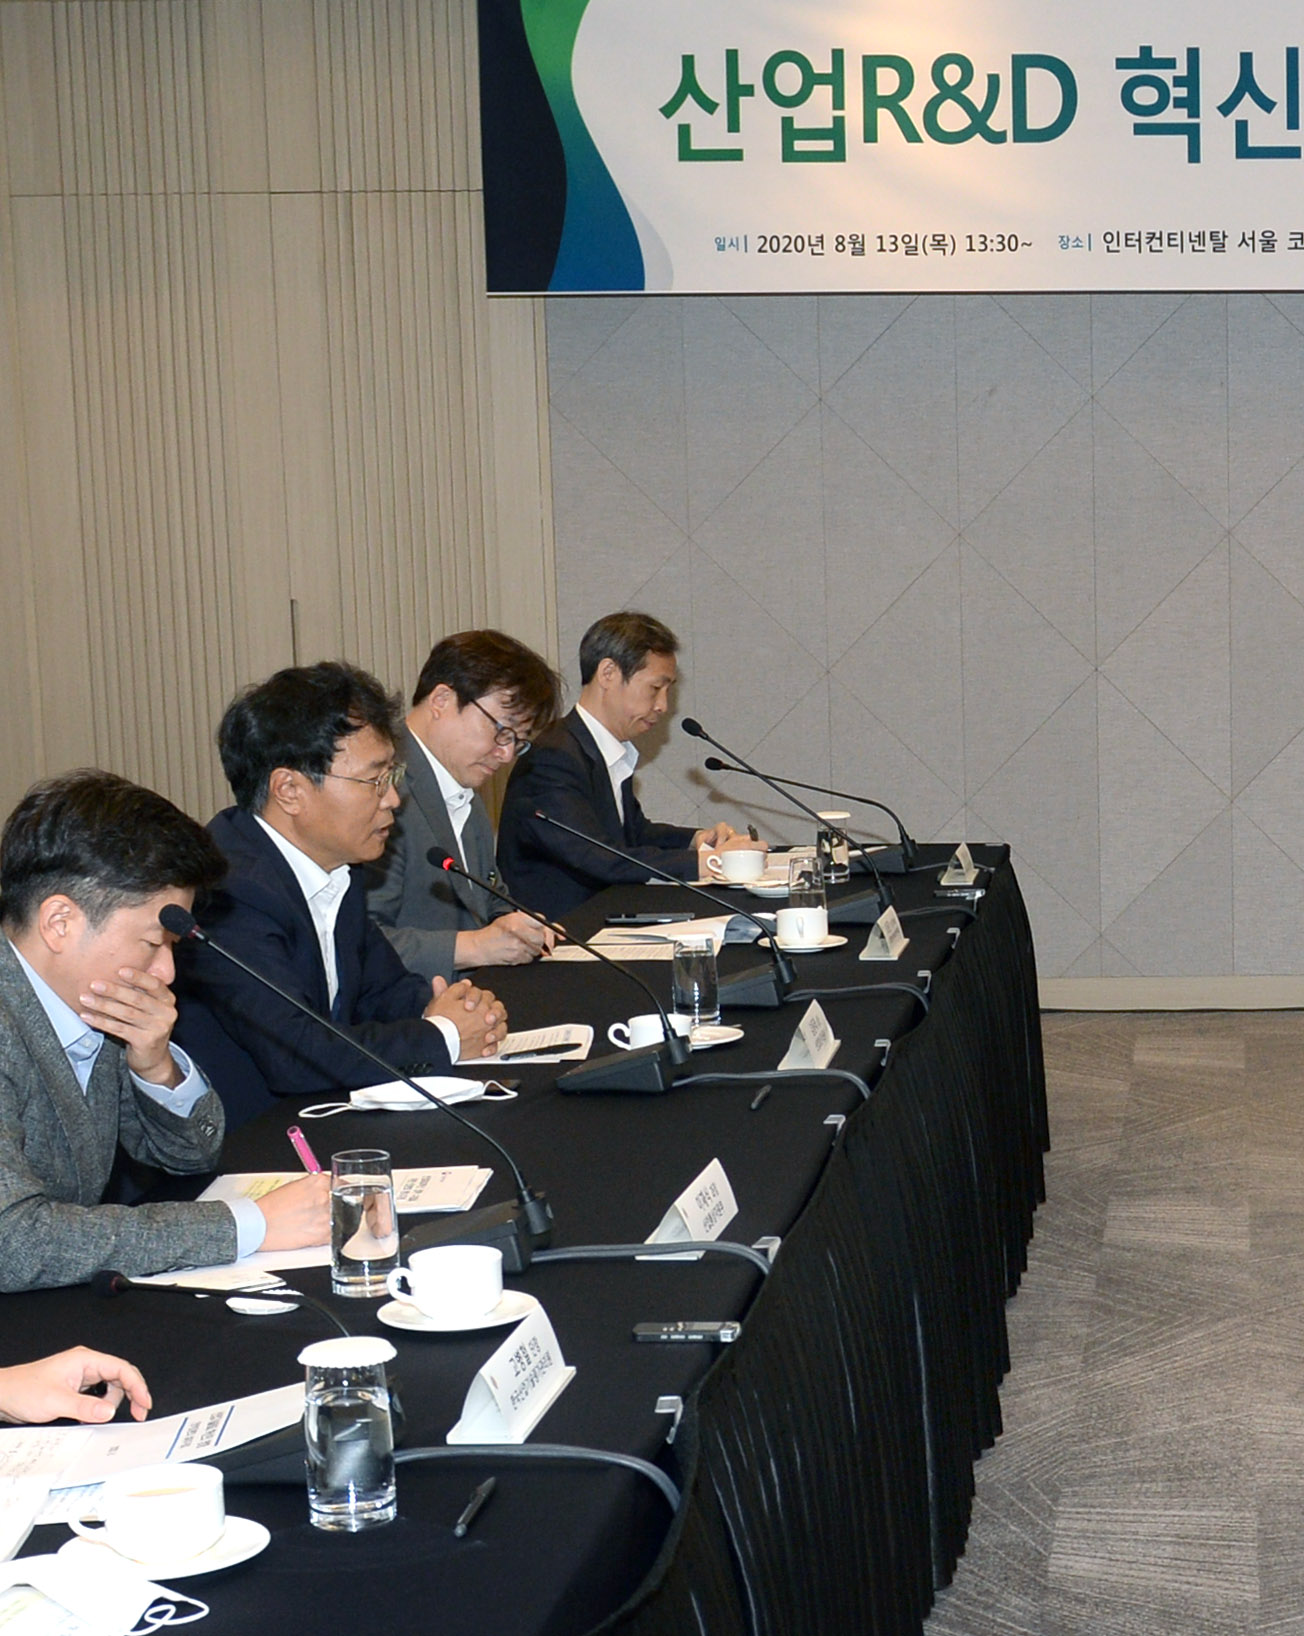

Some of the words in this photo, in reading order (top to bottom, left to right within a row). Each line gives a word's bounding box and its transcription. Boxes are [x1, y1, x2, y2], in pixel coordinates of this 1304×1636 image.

[659, 48, 1078, 163] 산업R&D
[1115, 45, 1301, 163] 혁신
[714, 236, 739, 251] 일시
[757, 234, 825, 256] 2020년
[834, 234, 866, 256] 8월
[876, 233, 957, 257] 13일(목)
[965, 233, 1033, 253] 13:30~
[1058, 234, 1084, 250] 장소
[1103, 230, 1229, 254] 인터컨티넨탈
[1237, 230, 1278, 254] 서울
